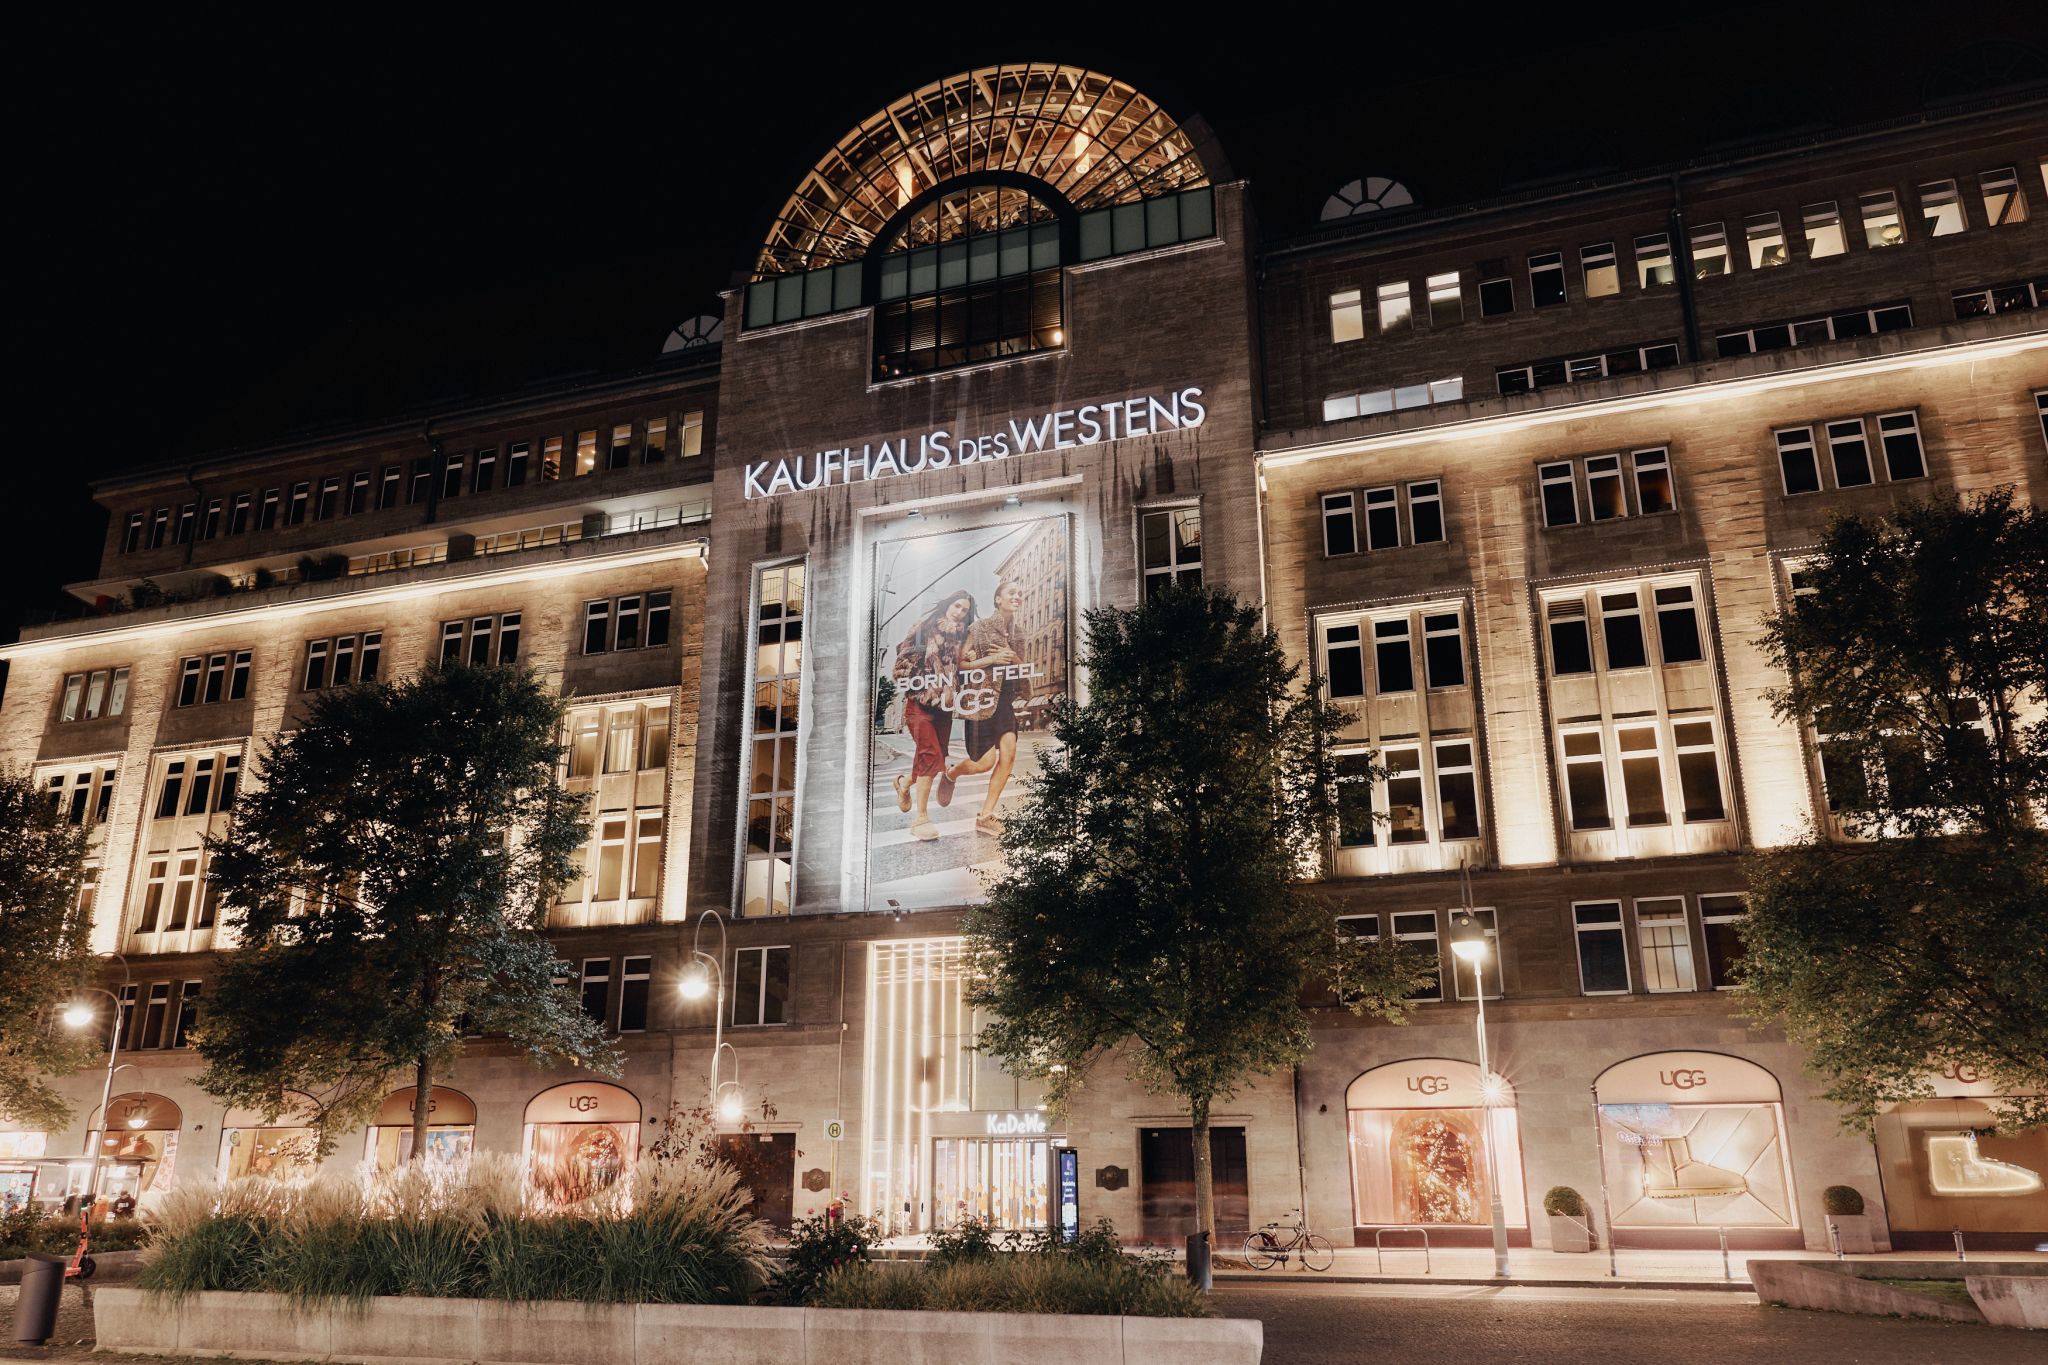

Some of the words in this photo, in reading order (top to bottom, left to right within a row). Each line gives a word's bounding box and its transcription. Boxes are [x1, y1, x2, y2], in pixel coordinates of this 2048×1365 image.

[745, 431, 953, 500] KAUFHAUS
[959, 432, 1010, 466] DES
[1009, 387, 1206, 454] WESTENS
[897, 673, 953, 692] BORN
[960, 668, 986, 684] TO
[992, 662, 1044, 681] FEEL
[940, 688, 994, 715] UGG
[1660, 1069, 1707, 1090] UGG
[1943, 1063, 1990, 1083] UG
[1407, 1075, 1450, 1095] UGG
[410, 1100, 436, 1112] UG
[569, 1096, 598, 1112] UGG
[987, 1113, 1046, 1134] KaDeWe
